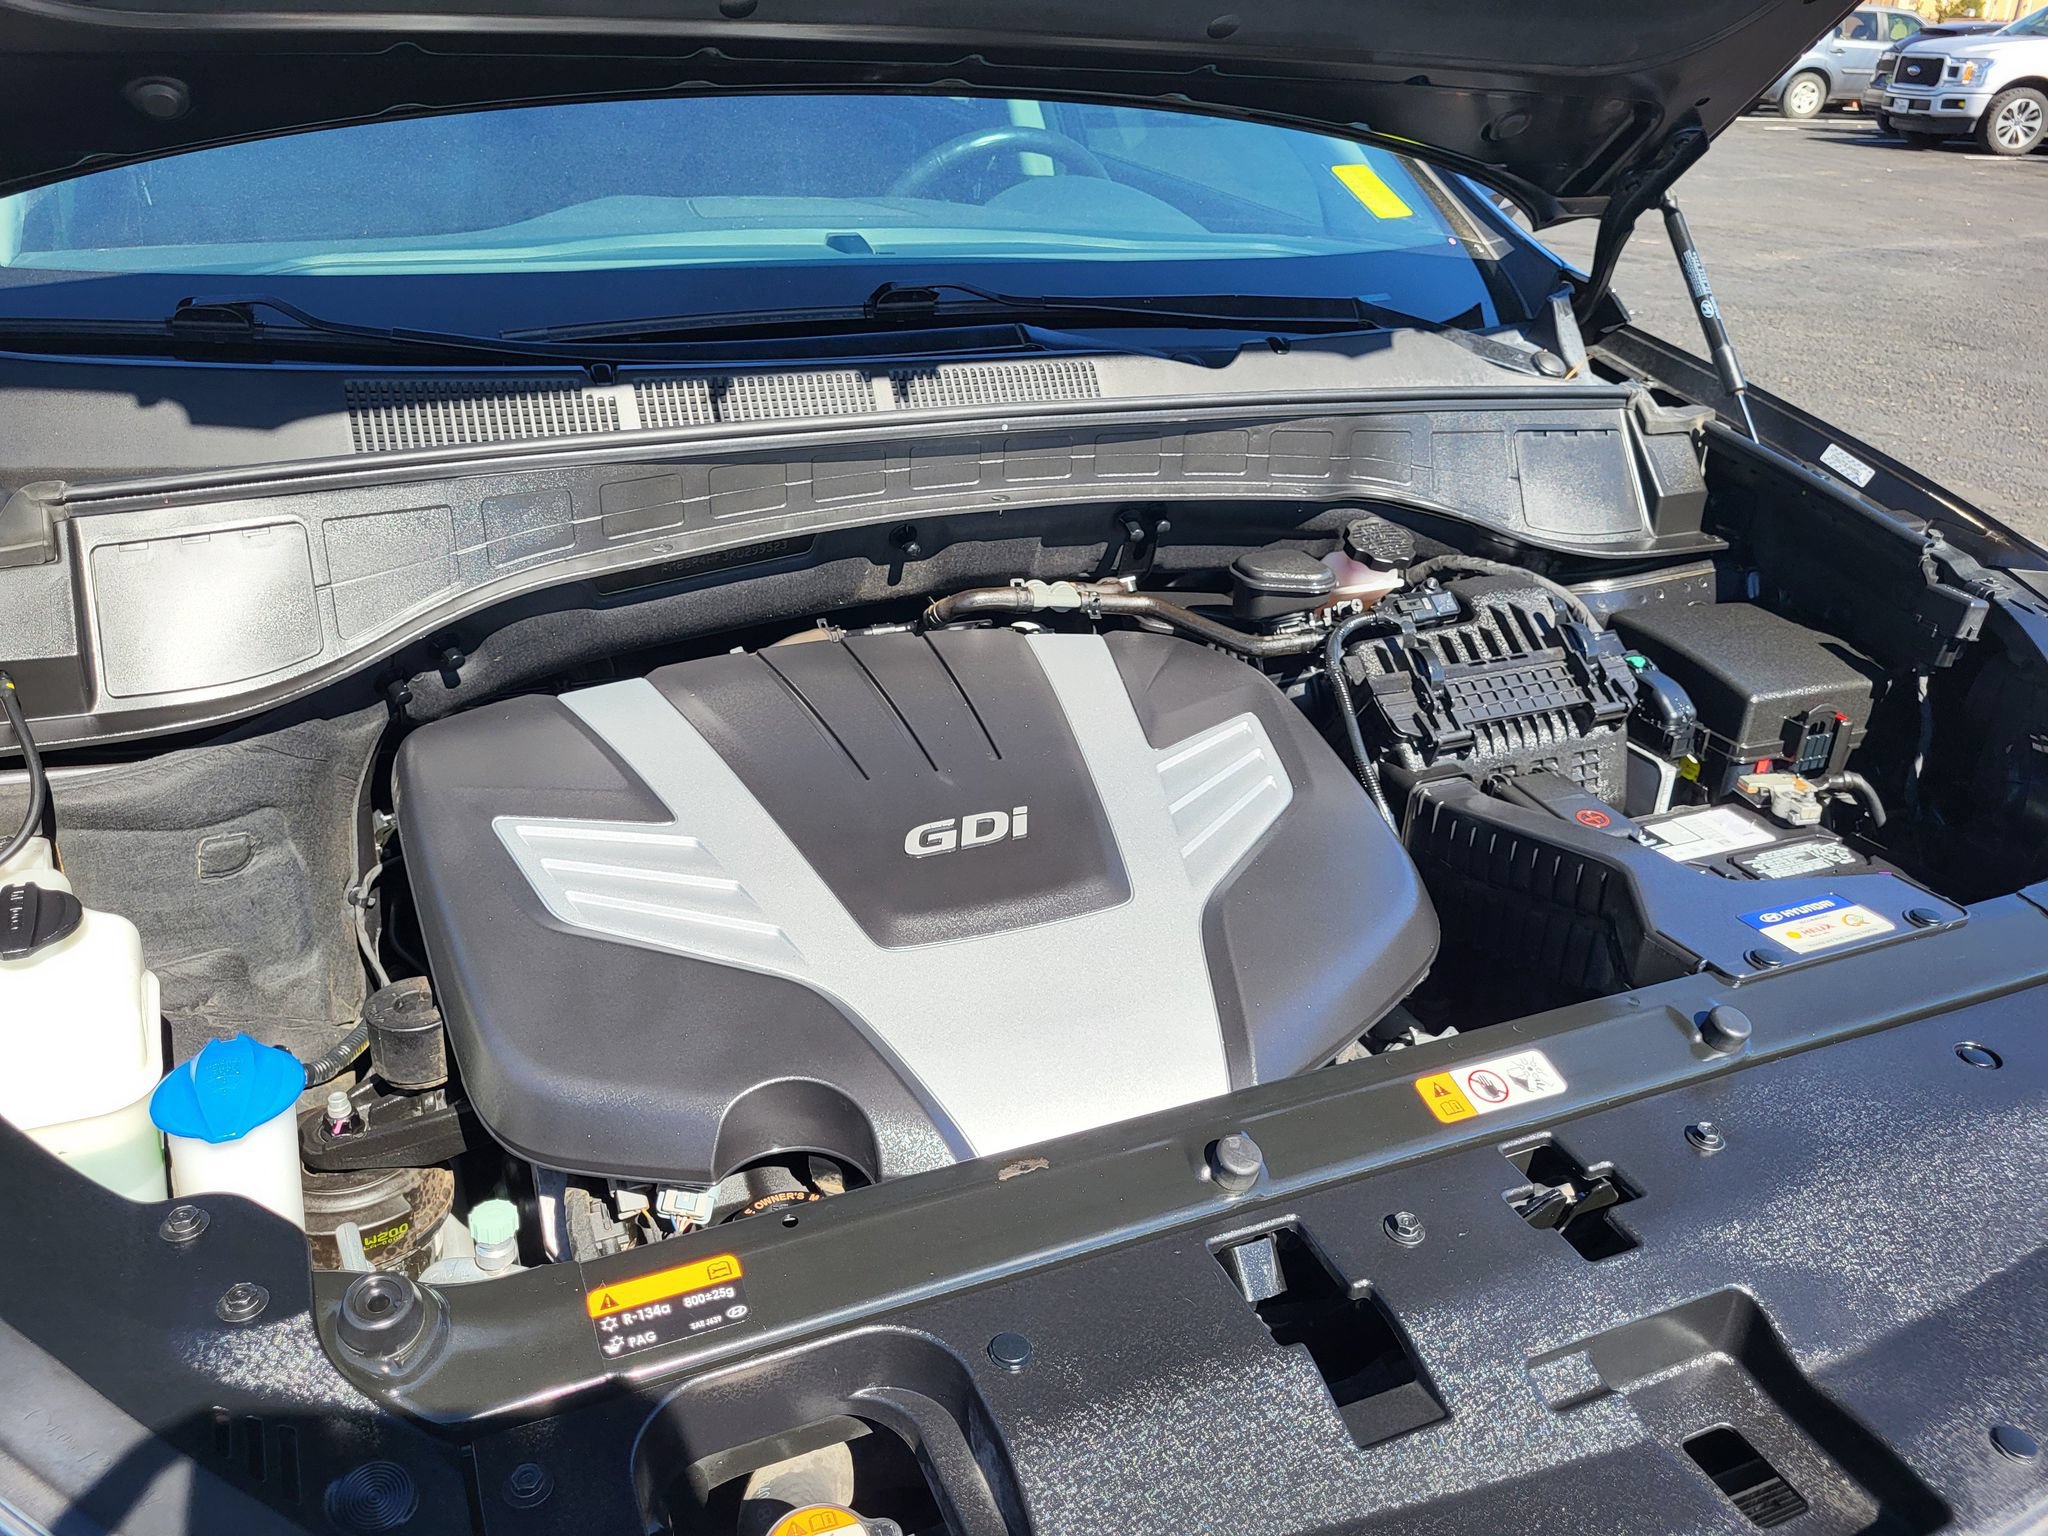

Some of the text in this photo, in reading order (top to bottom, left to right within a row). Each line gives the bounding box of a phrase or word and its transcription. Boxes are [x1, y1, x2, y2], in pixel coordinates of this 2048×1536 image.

[904, 805, 1028, 858] GDi
[1779, 899, 1836, 918] HYUNDAI
[754, 1192, 805, 1210] OWNER'S
[364, 1222, 409, 1246] W200
[621, 1286, 735, 1326] R-134a 800±25g
[627, 1331, 657, 1348] PAG
